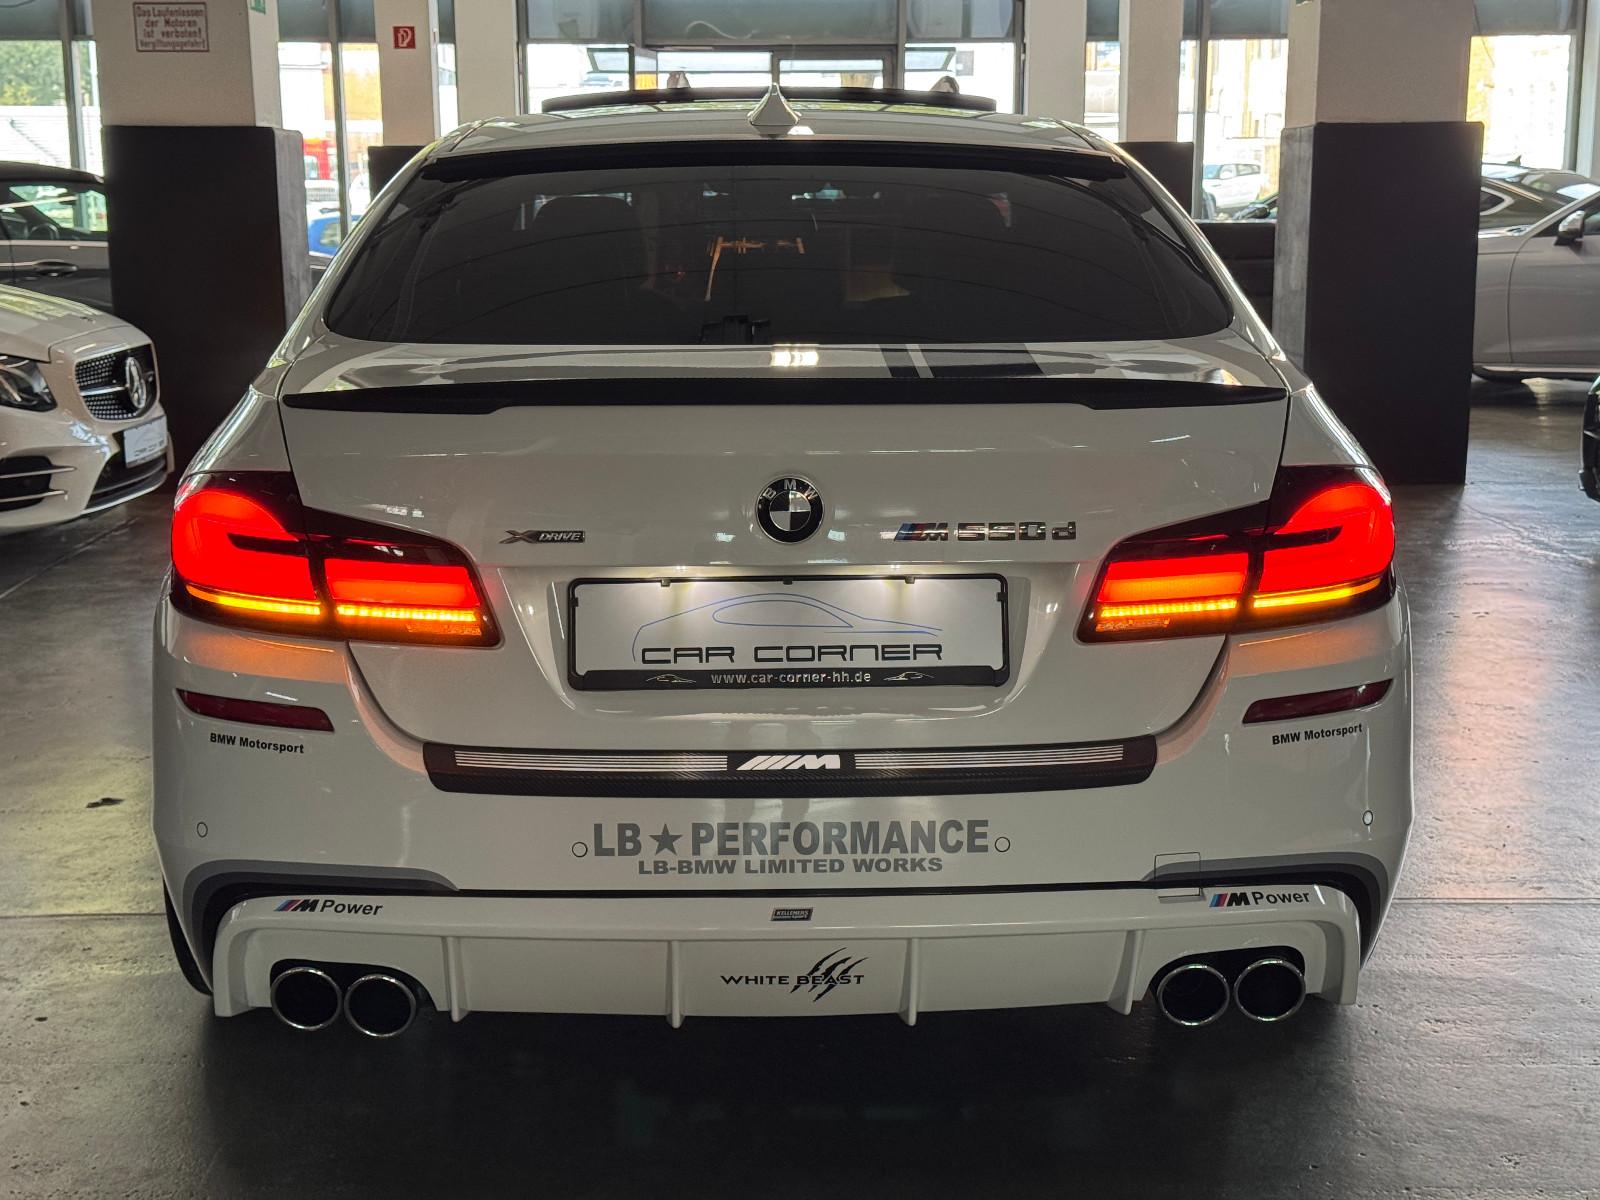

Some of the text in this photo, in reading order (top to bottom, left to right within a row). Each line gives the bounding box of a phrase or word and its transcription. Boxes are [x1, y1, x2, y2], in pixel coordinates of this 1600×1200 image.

[164, 18, 198, 28] Motoren
[762, 479, 818, 500] BMW
[641, 643, 943, 664] CAR CORNER
[710, 671, 872, 685] www.car-corner-hh.de
[209, 732, 305, 754] BMW Motorsport
[1271, 722, 1363, 746] BMW Motorsport
[593, 819, 989, 857] LB PERFORMANCE
[638, 857, 943, 875] LB-BMW LIMITED WORKS
[1251, 891, 1310, 905] Power
[319, 899, 384, 916] Power
[720, 974, 865, 986] WHITE BEAST
